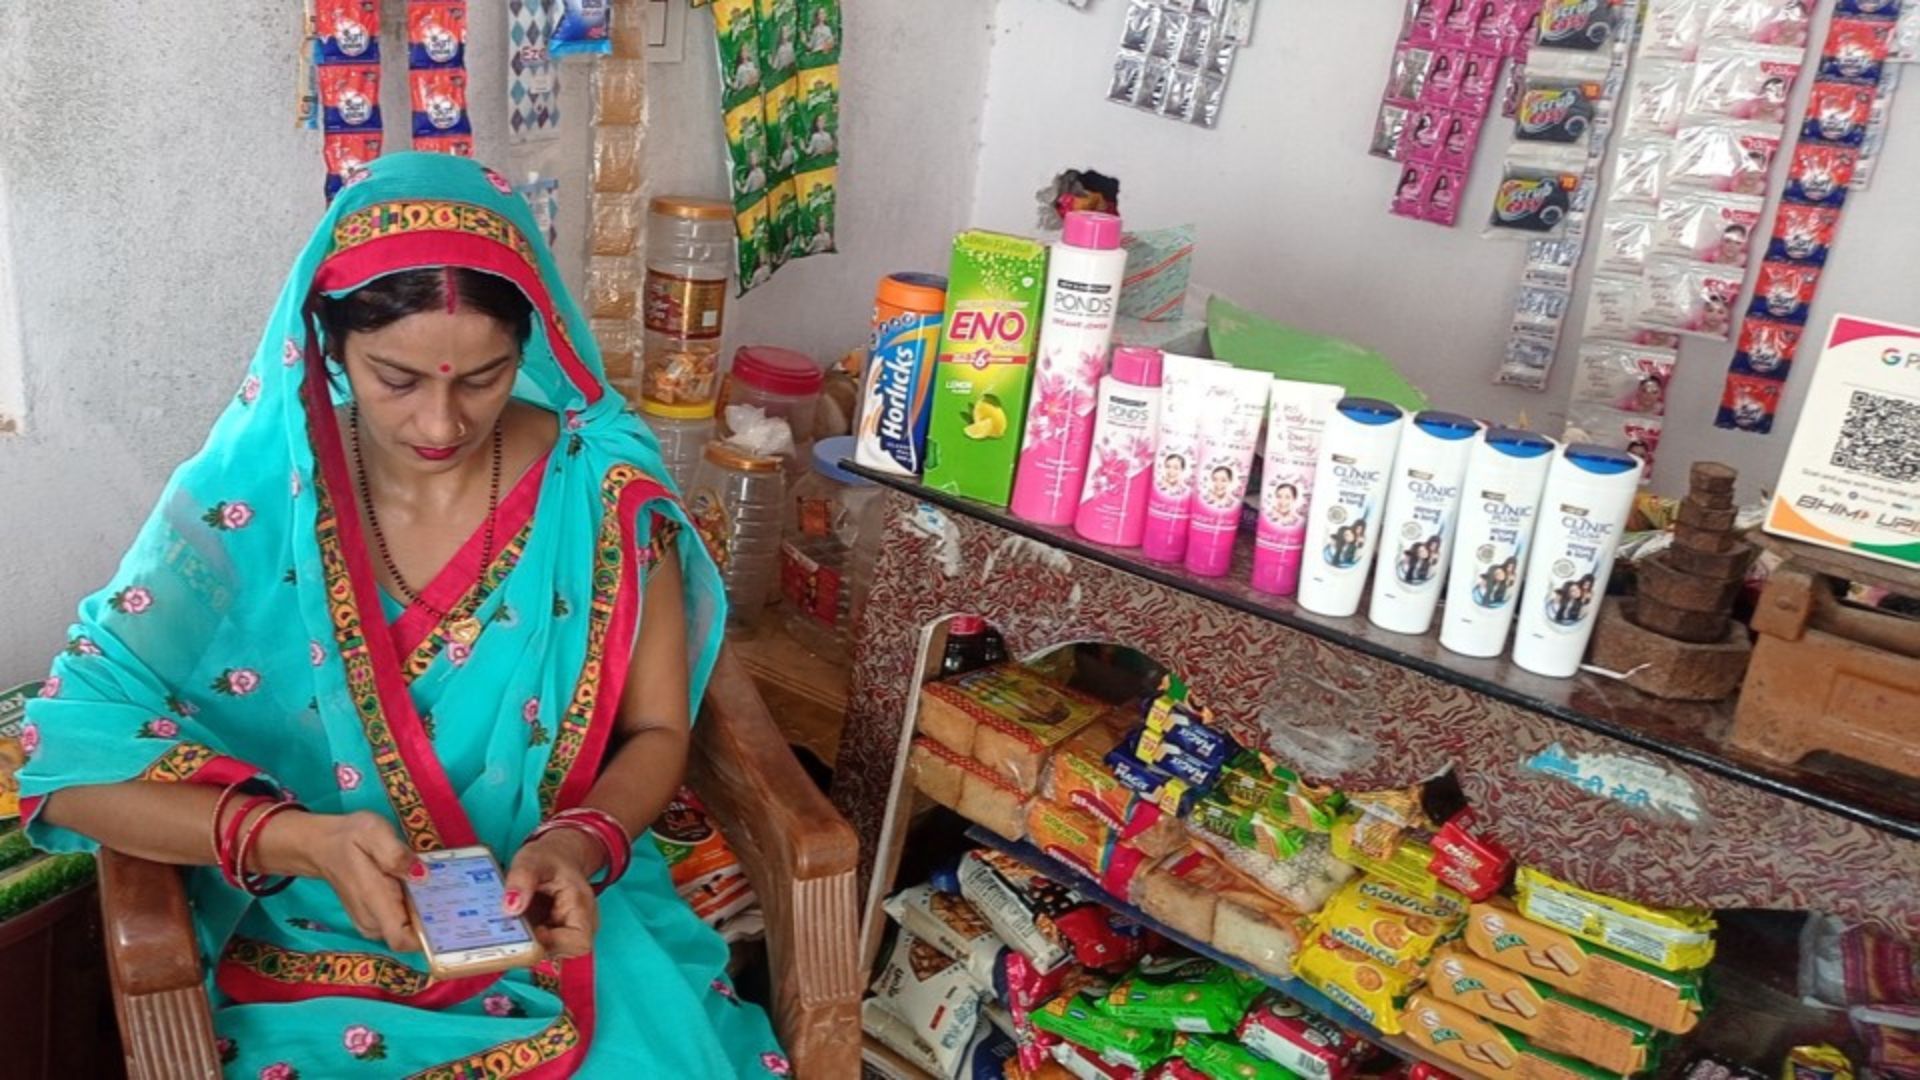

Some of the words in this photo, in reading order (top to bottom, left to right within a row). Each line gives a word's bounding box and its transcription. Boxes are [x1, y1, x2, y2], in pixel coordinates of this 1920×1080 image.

[948, 310, 1027, 342] ENO
[880, 345, 915, 440] Horlicks
[1332, 466, 1380, 482] CLINIC
[1407, 481, 1457, 498] CLINIC
[1483, 502, 1533, 518] CLINIC
[1561, 516, 1614, 535] CLINIC
[1359, 883, 1450, 918] MONACO
[1331, 927, 1398, 968] MONACO
